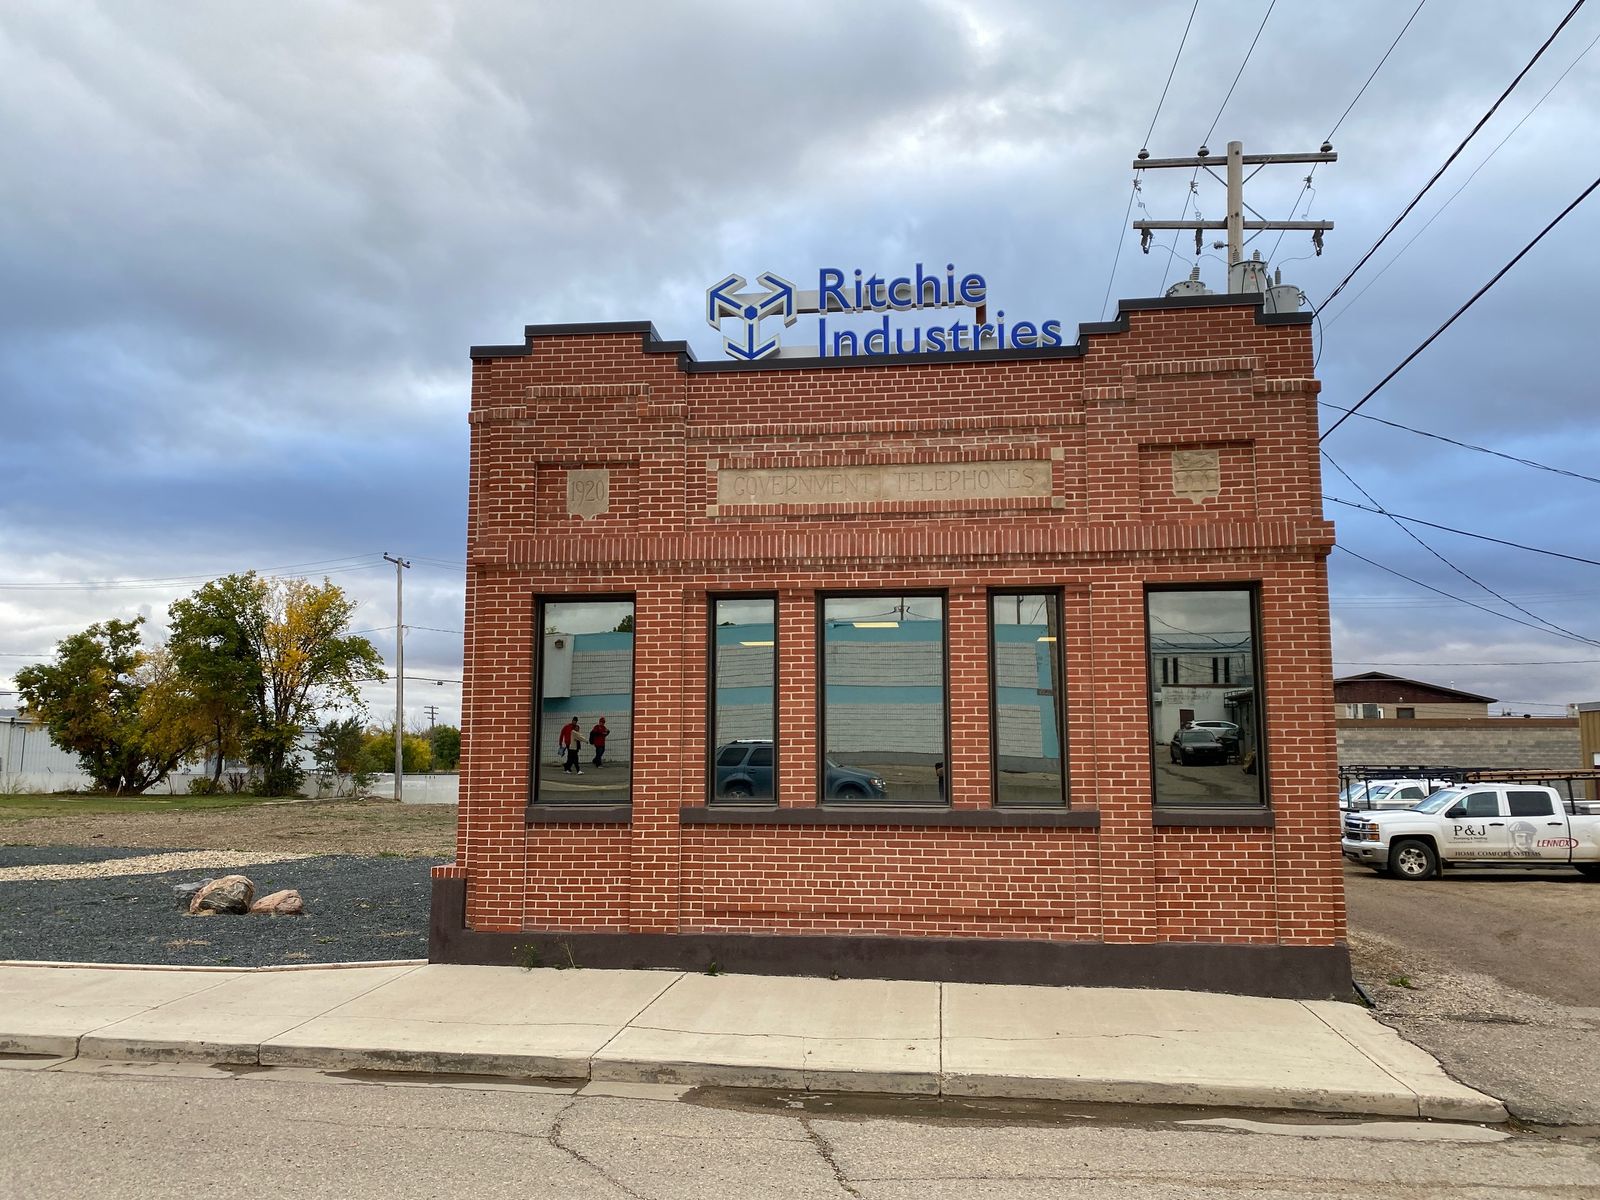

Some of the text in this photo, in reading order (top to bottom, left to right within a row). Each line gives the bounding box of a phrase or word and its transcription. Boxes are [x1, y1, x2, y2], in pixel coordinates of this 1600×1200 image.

[818, 262, 987, 311] Ritchie
[818, 310, 1063, 357] Industries
[571, 480, 605, 507] 1920
[733, 468, 1035, 496] GOVERNMENT TELEPHONES
[1454, 825, 1487, 836] P & J
[1536, 839, 1571, 848] LENNOX
